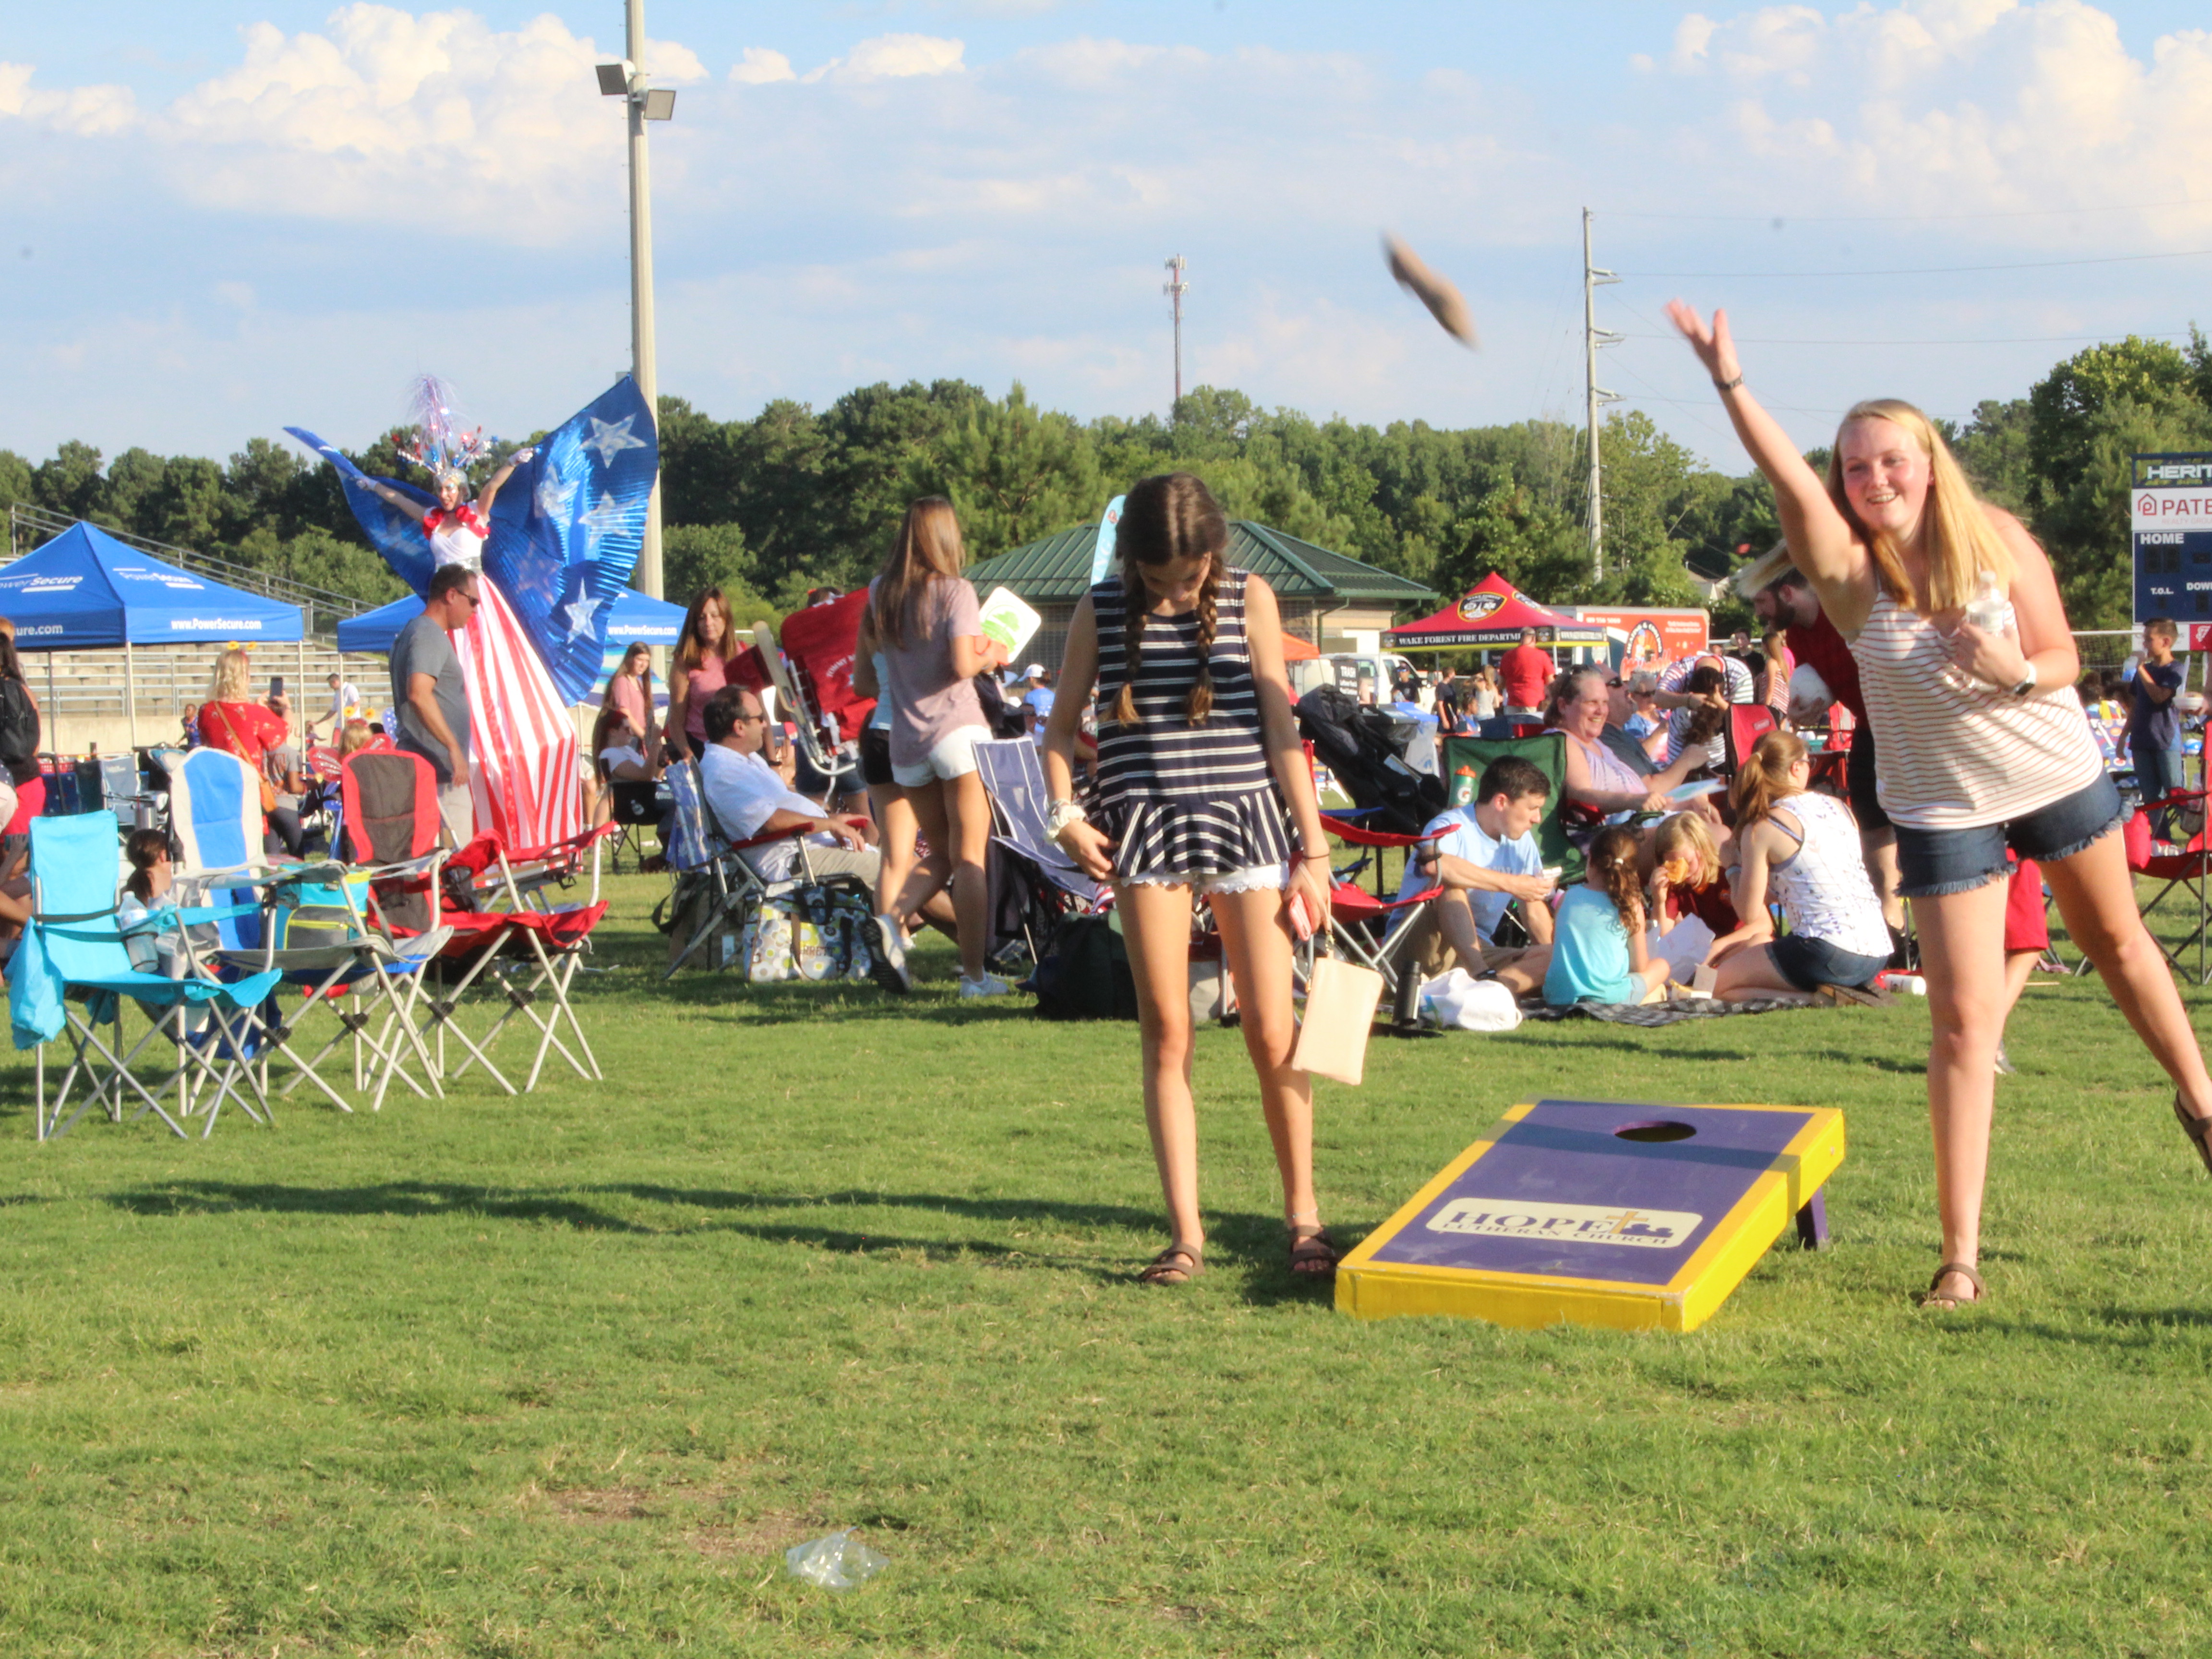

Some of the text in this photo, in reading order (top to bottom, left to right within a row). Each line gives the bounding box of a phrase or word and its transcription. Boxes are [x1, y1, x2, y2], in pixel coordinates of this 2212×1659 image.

[2140, 533, 2184, 545] HOME
[2186, 582, 2212, 591] DOW
[170, 617, 262, 630] www.PowerSecure.com
[16, 625, 63, 636] ure.com
[608, 625, 677, 636] www.PowerSecure.com
[1424, 635, 1456, 644] FOREST
[1457, 634, 1477, 642] FIRE
[1450, 1212, 1613, 1233] HOPE
[1443, 1223, 1669, 1244] LUTHERAN CHURCH
